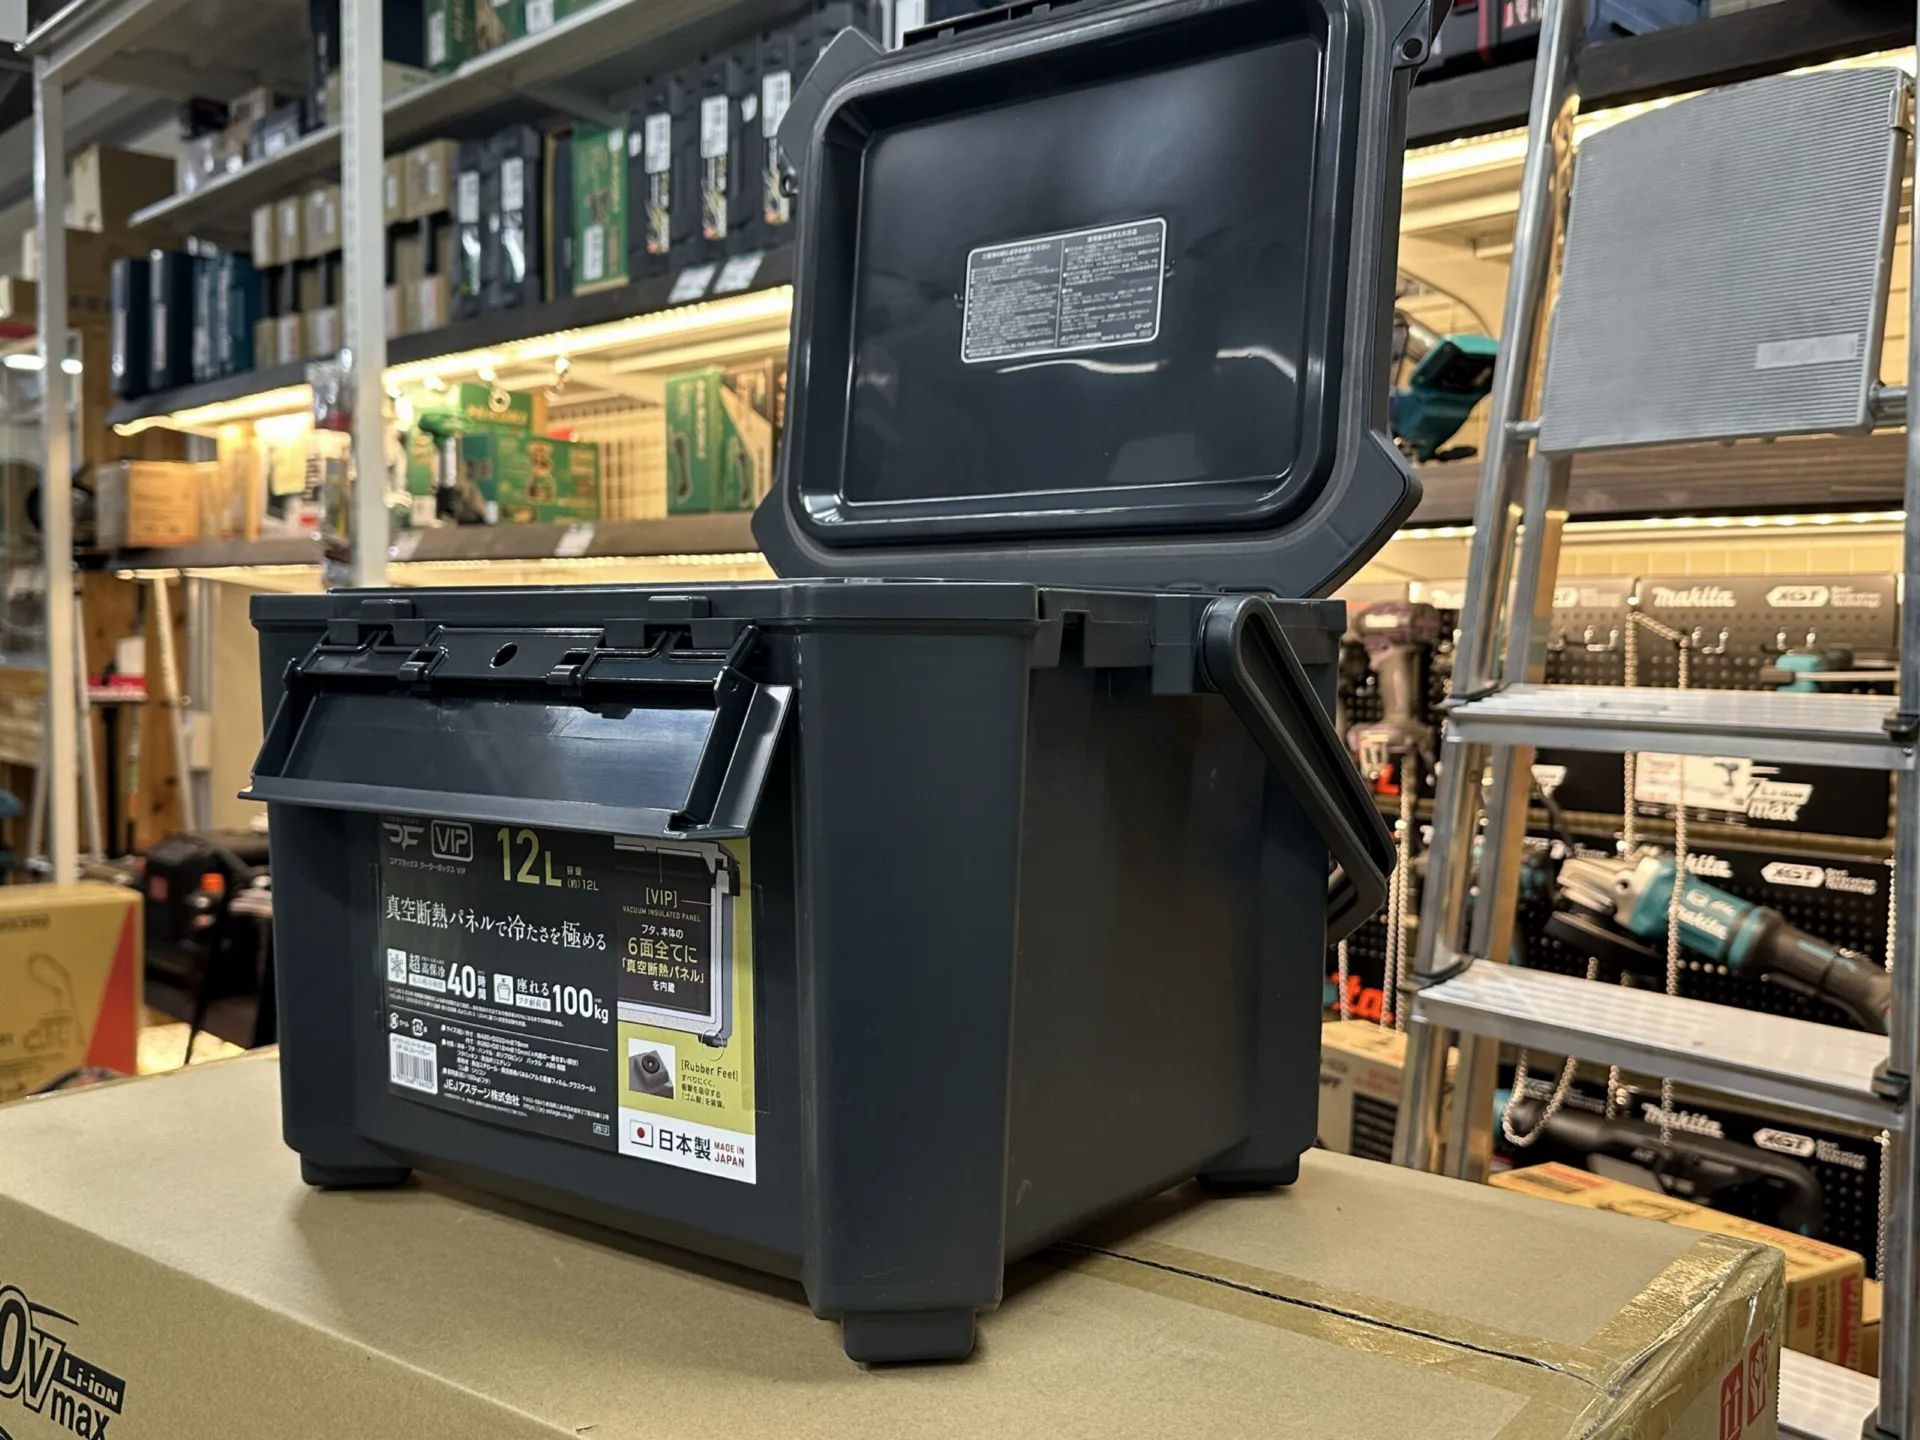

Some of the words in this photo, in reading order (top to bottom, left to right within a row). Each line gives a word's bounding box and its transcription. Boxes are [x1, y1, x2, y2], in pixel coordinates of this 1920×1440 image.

[434, 825, 470, 855] VIP
[497, 827, 562, 887] 12L
[386, 894, 607, 951] 真空断熱パネルで冷たさを極める
[622, 905, 647, 915] VACUUM
[647, 908, 680, 920] INSULATED
[681, 914, 701, 923] PANEL
[641, 924, 684, 939] フタ、本体の
[628, 937, 698, 963] 6面全てに
[447, 962, 476, 998] 40
[622, 957, 705, 984] 「真空断熱パネル」
[516, 977, 549, 997] 座れる
[652, 980, 676, 994] を内蔵
[681, 1059, 715, 1076] [Rubber
[717, 1066, 739, 1082] Feet]
[443, 1079, 521, 1107] JEJアステージ株式会社
[659, 1128, 712, 1161] 日本製
[714, 1141, 735, 1153] MADE
[736, 1147, 745, 1155] IN
[714, 1152, 745, 1168] JAPAN
